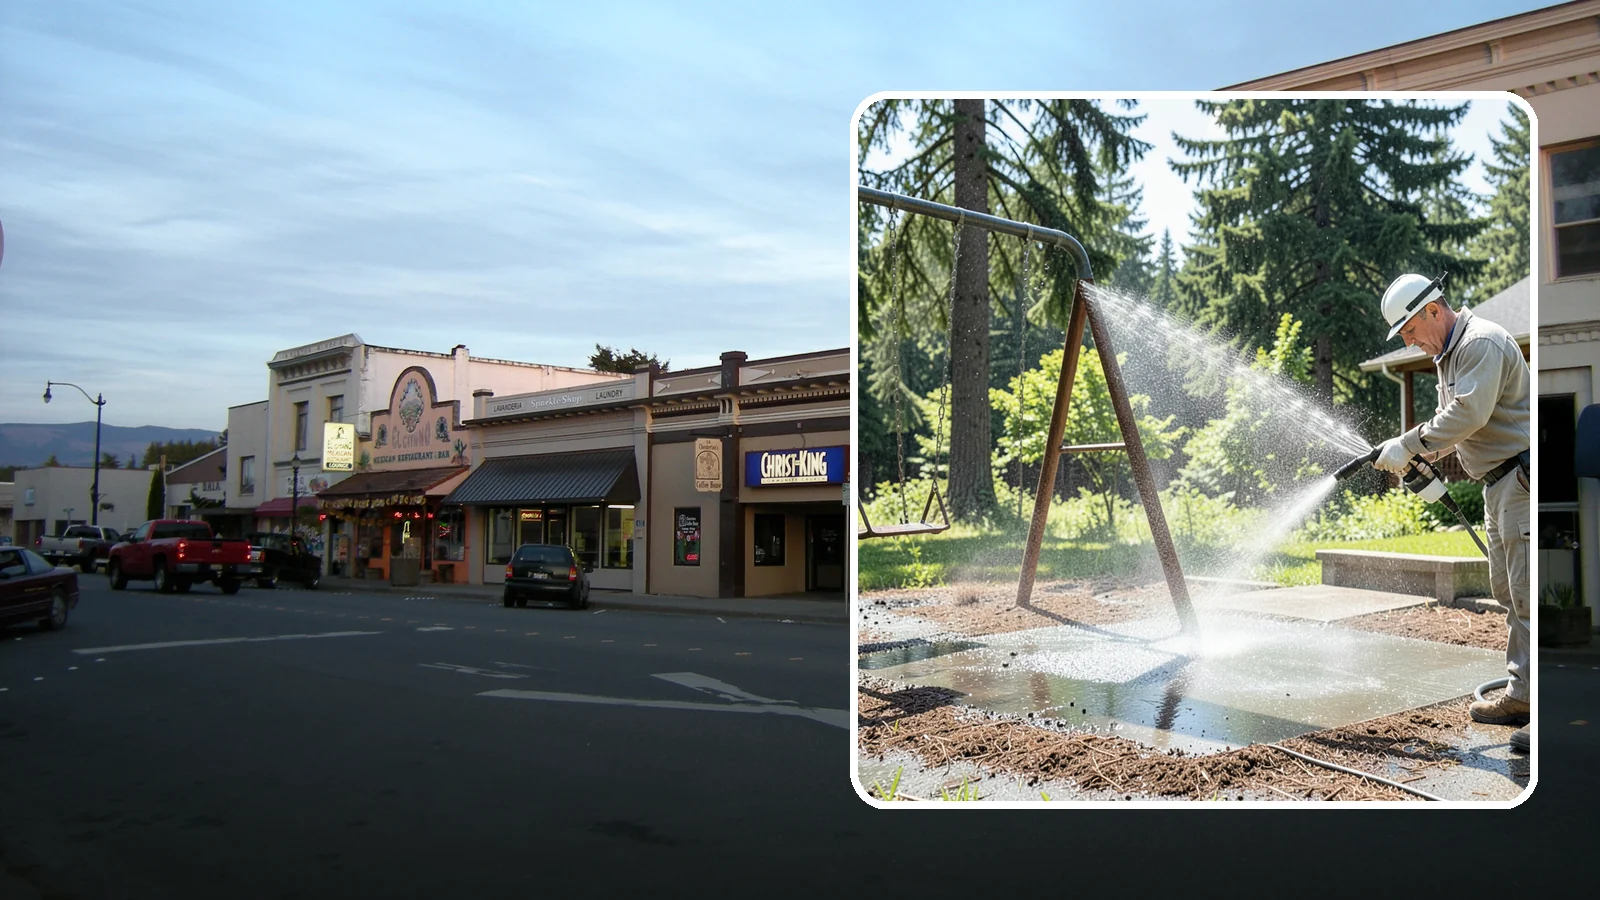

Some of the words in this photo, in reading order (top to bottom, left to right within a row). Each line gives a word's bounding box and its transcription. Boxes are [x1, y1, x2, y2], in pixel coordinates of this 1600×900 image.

[530, 396, 561, 409] Sparkle
[562, 394, 583, 407] Shop
[595, 389, 623, 400] LAUNDRY
[493, 402, 523, 412] LAVANDERIA
[373, 454, 396, 464] MEXICAN
[397, 451, 433, 462] RESTAURANT
[437, 450, 450, 459] BAR
[761, 451, 797, 478] CHRIST
[798, 450, 828, 476] KING
